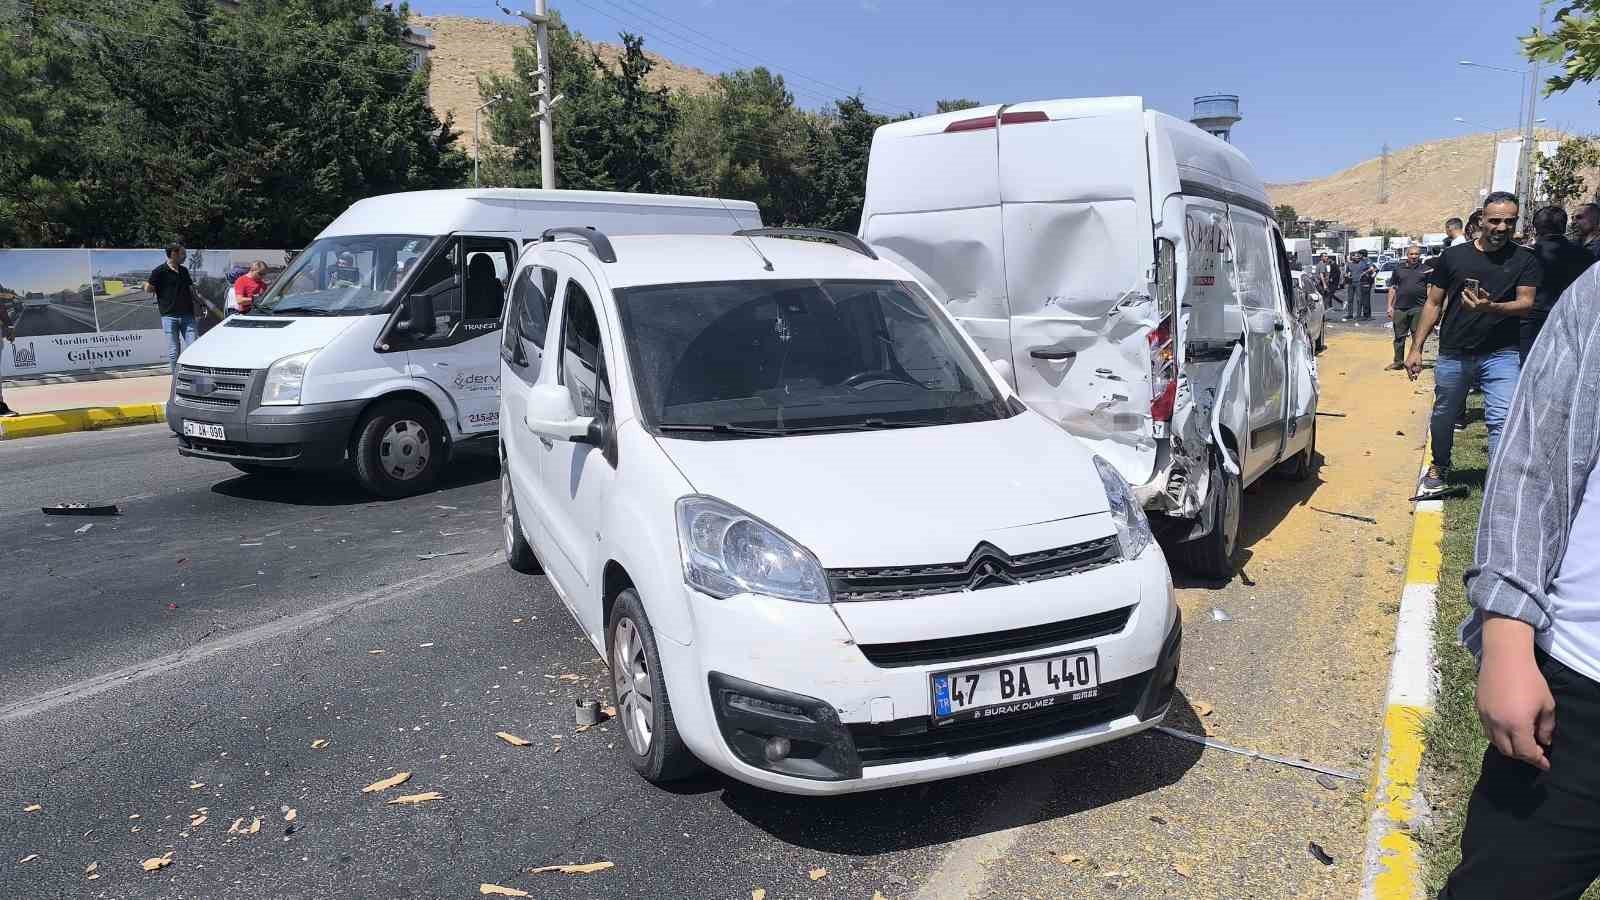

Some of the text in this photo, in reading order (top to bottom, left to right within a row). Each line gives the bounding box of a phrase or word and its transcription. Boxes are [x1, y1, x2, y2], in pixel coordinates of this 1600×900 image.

[463, 322, 497, 331] TRANSIT
[51, 335, 88, 347] Mardin
[951, 656, 1090, 707] 47 BA 440
[984, 703, 1021, 716] BURAK
